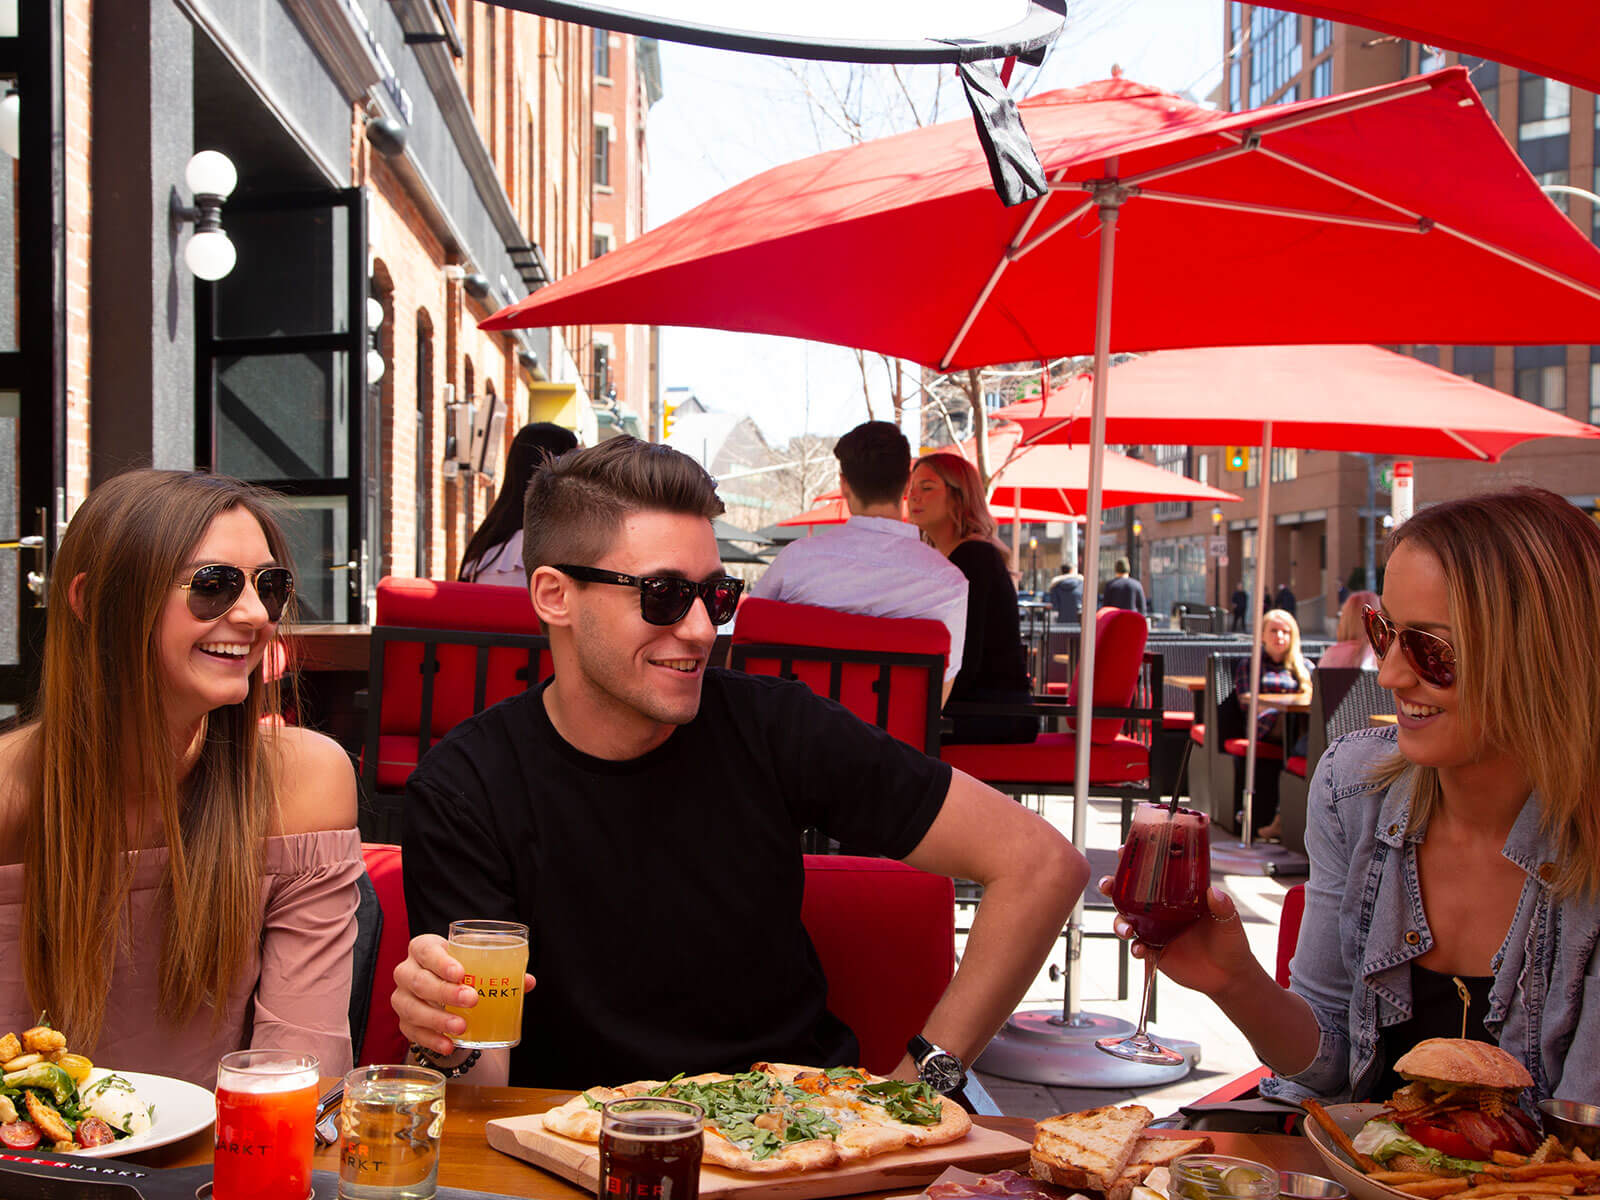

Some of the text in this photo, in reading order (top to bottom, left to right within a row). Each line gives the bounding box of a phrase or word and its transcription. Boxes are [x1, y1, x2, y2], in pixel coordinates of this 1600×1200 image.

[464, 975, 510, 987] BIER
[477, 987, 519, 998] ARKT
[216, 1138, 272, 1156] ARKT
[607, 1176, 665, 1197] BIER
